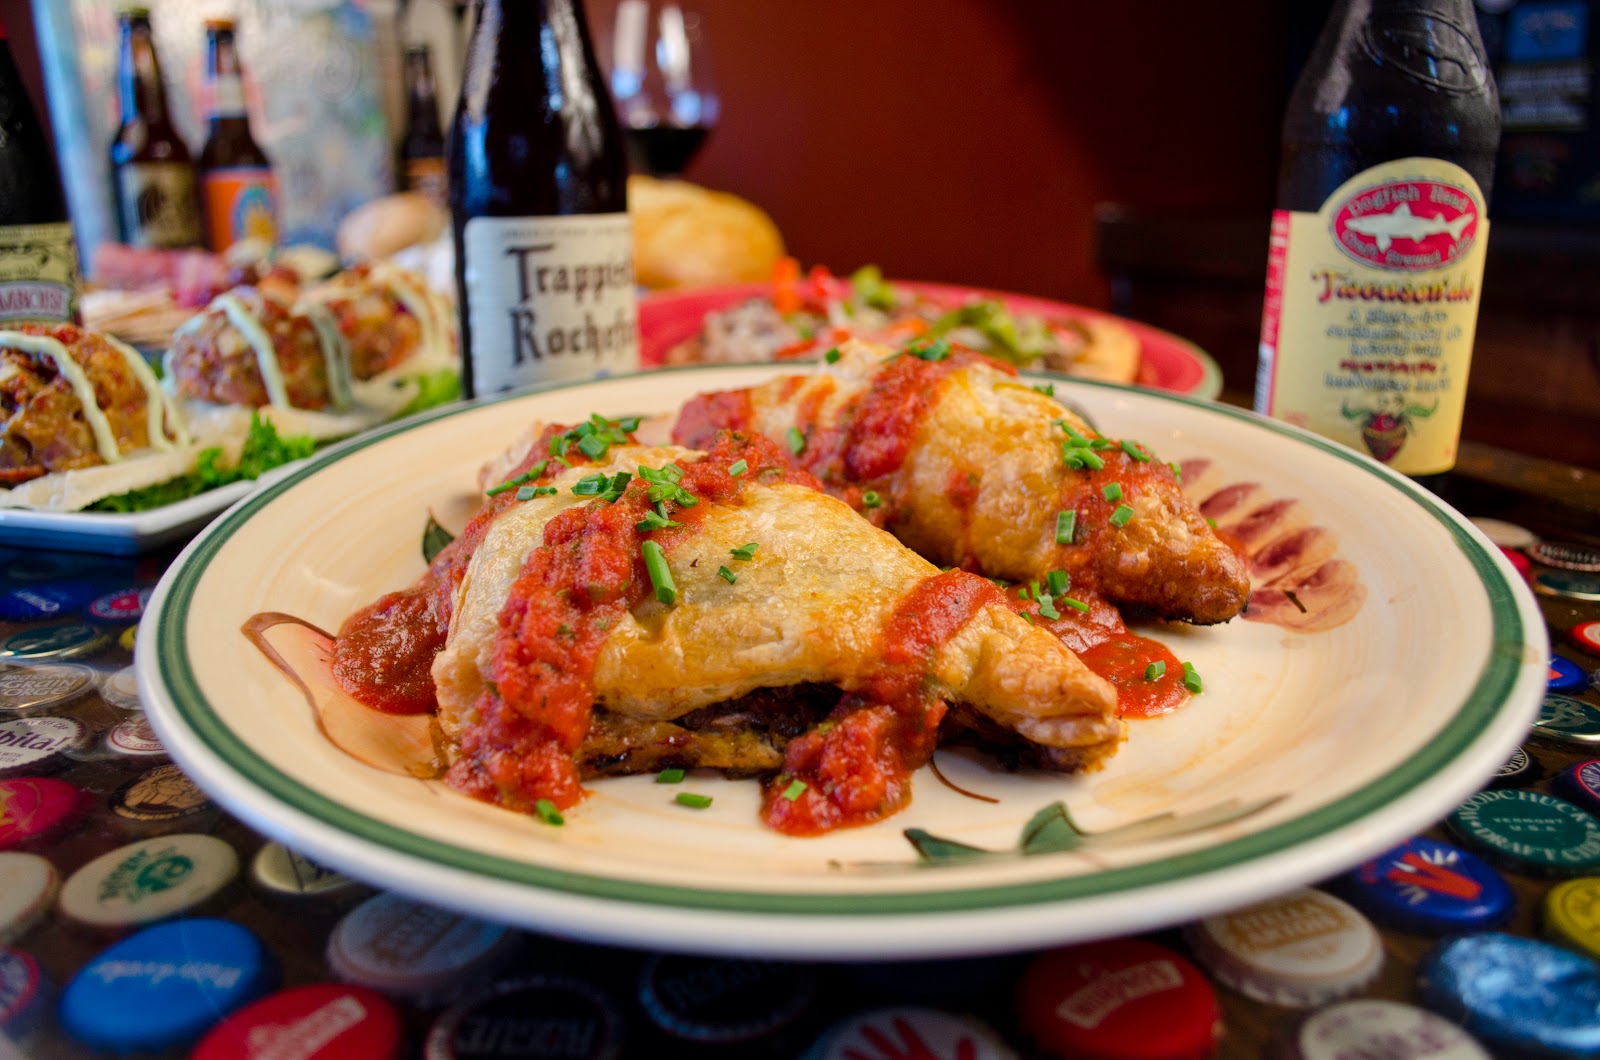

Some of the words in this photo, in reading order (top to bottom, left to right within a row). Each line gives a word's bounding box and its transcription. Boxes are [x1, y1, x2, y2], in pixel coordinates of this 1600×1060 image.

[1348, 185, 1421, 217] Dogfish
[1429, 185, 1470, 213] Head
[0, 730, 72, 751] bita!
[1458, 789, 1589, 822] WOODCHUCK
[1493, 817, 1563, 825] VERMONT
